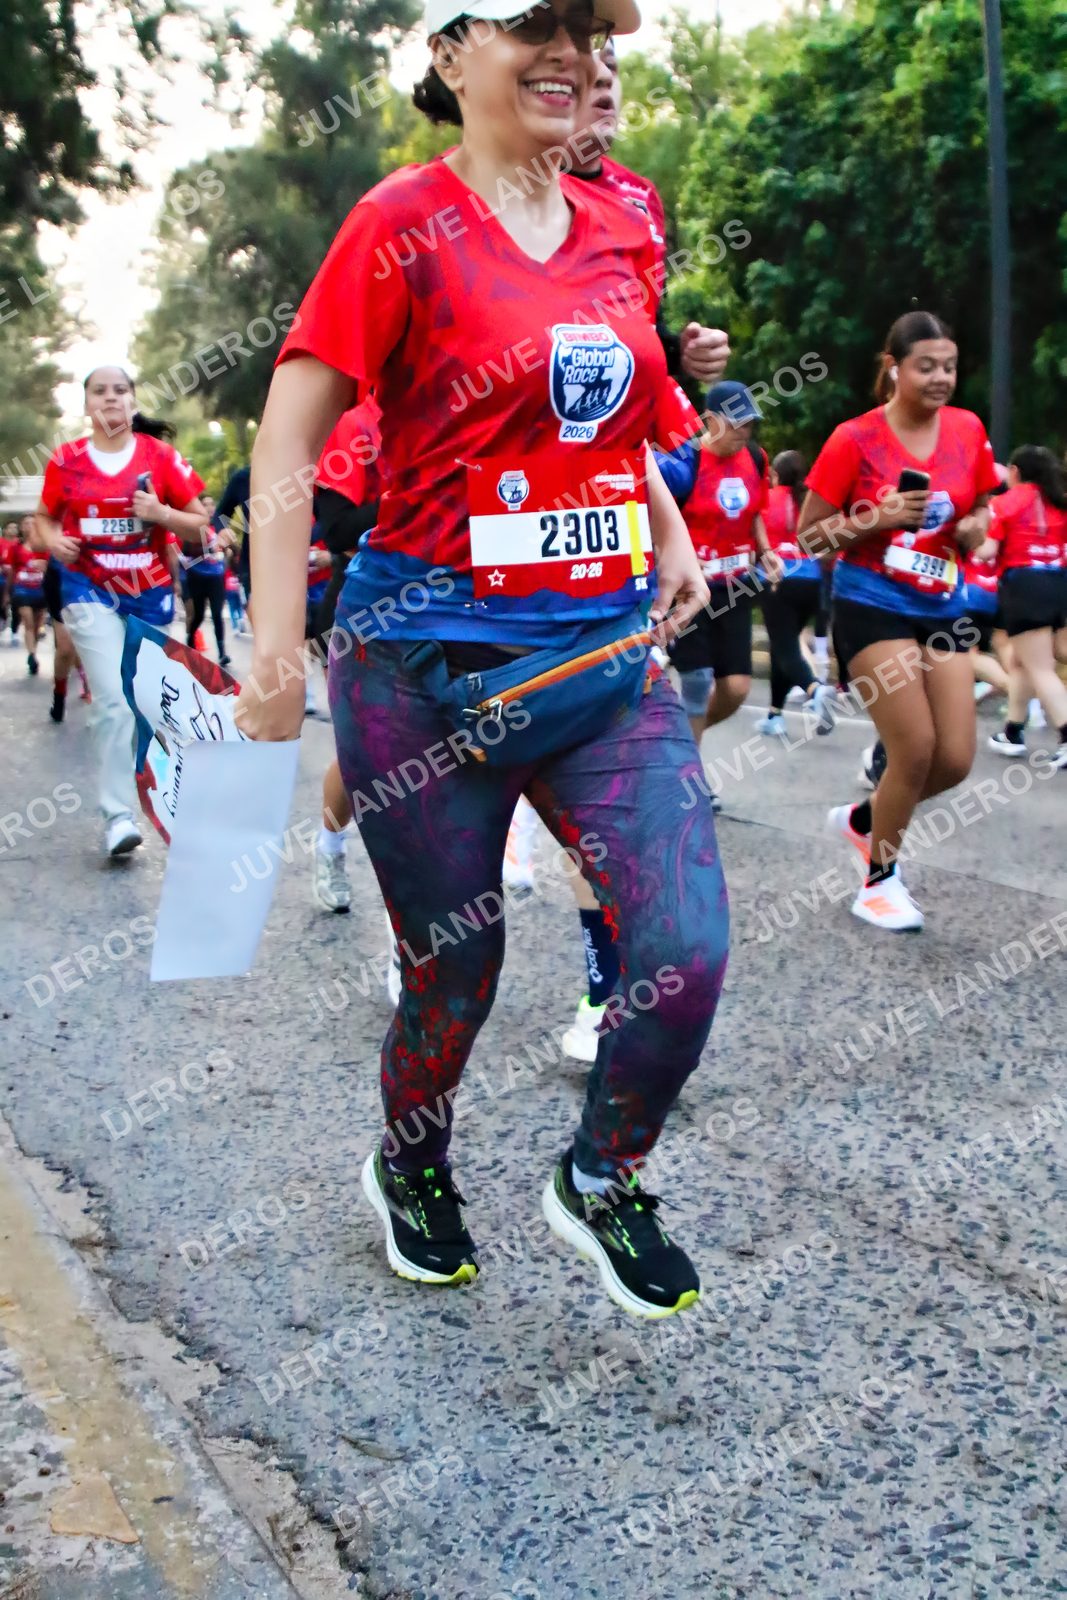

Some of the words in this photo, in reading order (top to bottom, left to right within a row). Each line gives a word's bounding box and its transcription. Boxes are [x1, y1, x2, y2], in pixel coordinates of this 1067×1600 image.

[571, 347, 615, 367] Global
[562, 365, 599, 384] Race
[562, 425, 594, 439] 2026
[102, 518, 135, 534] 2259
[539, 509, 620, 558] 2303
